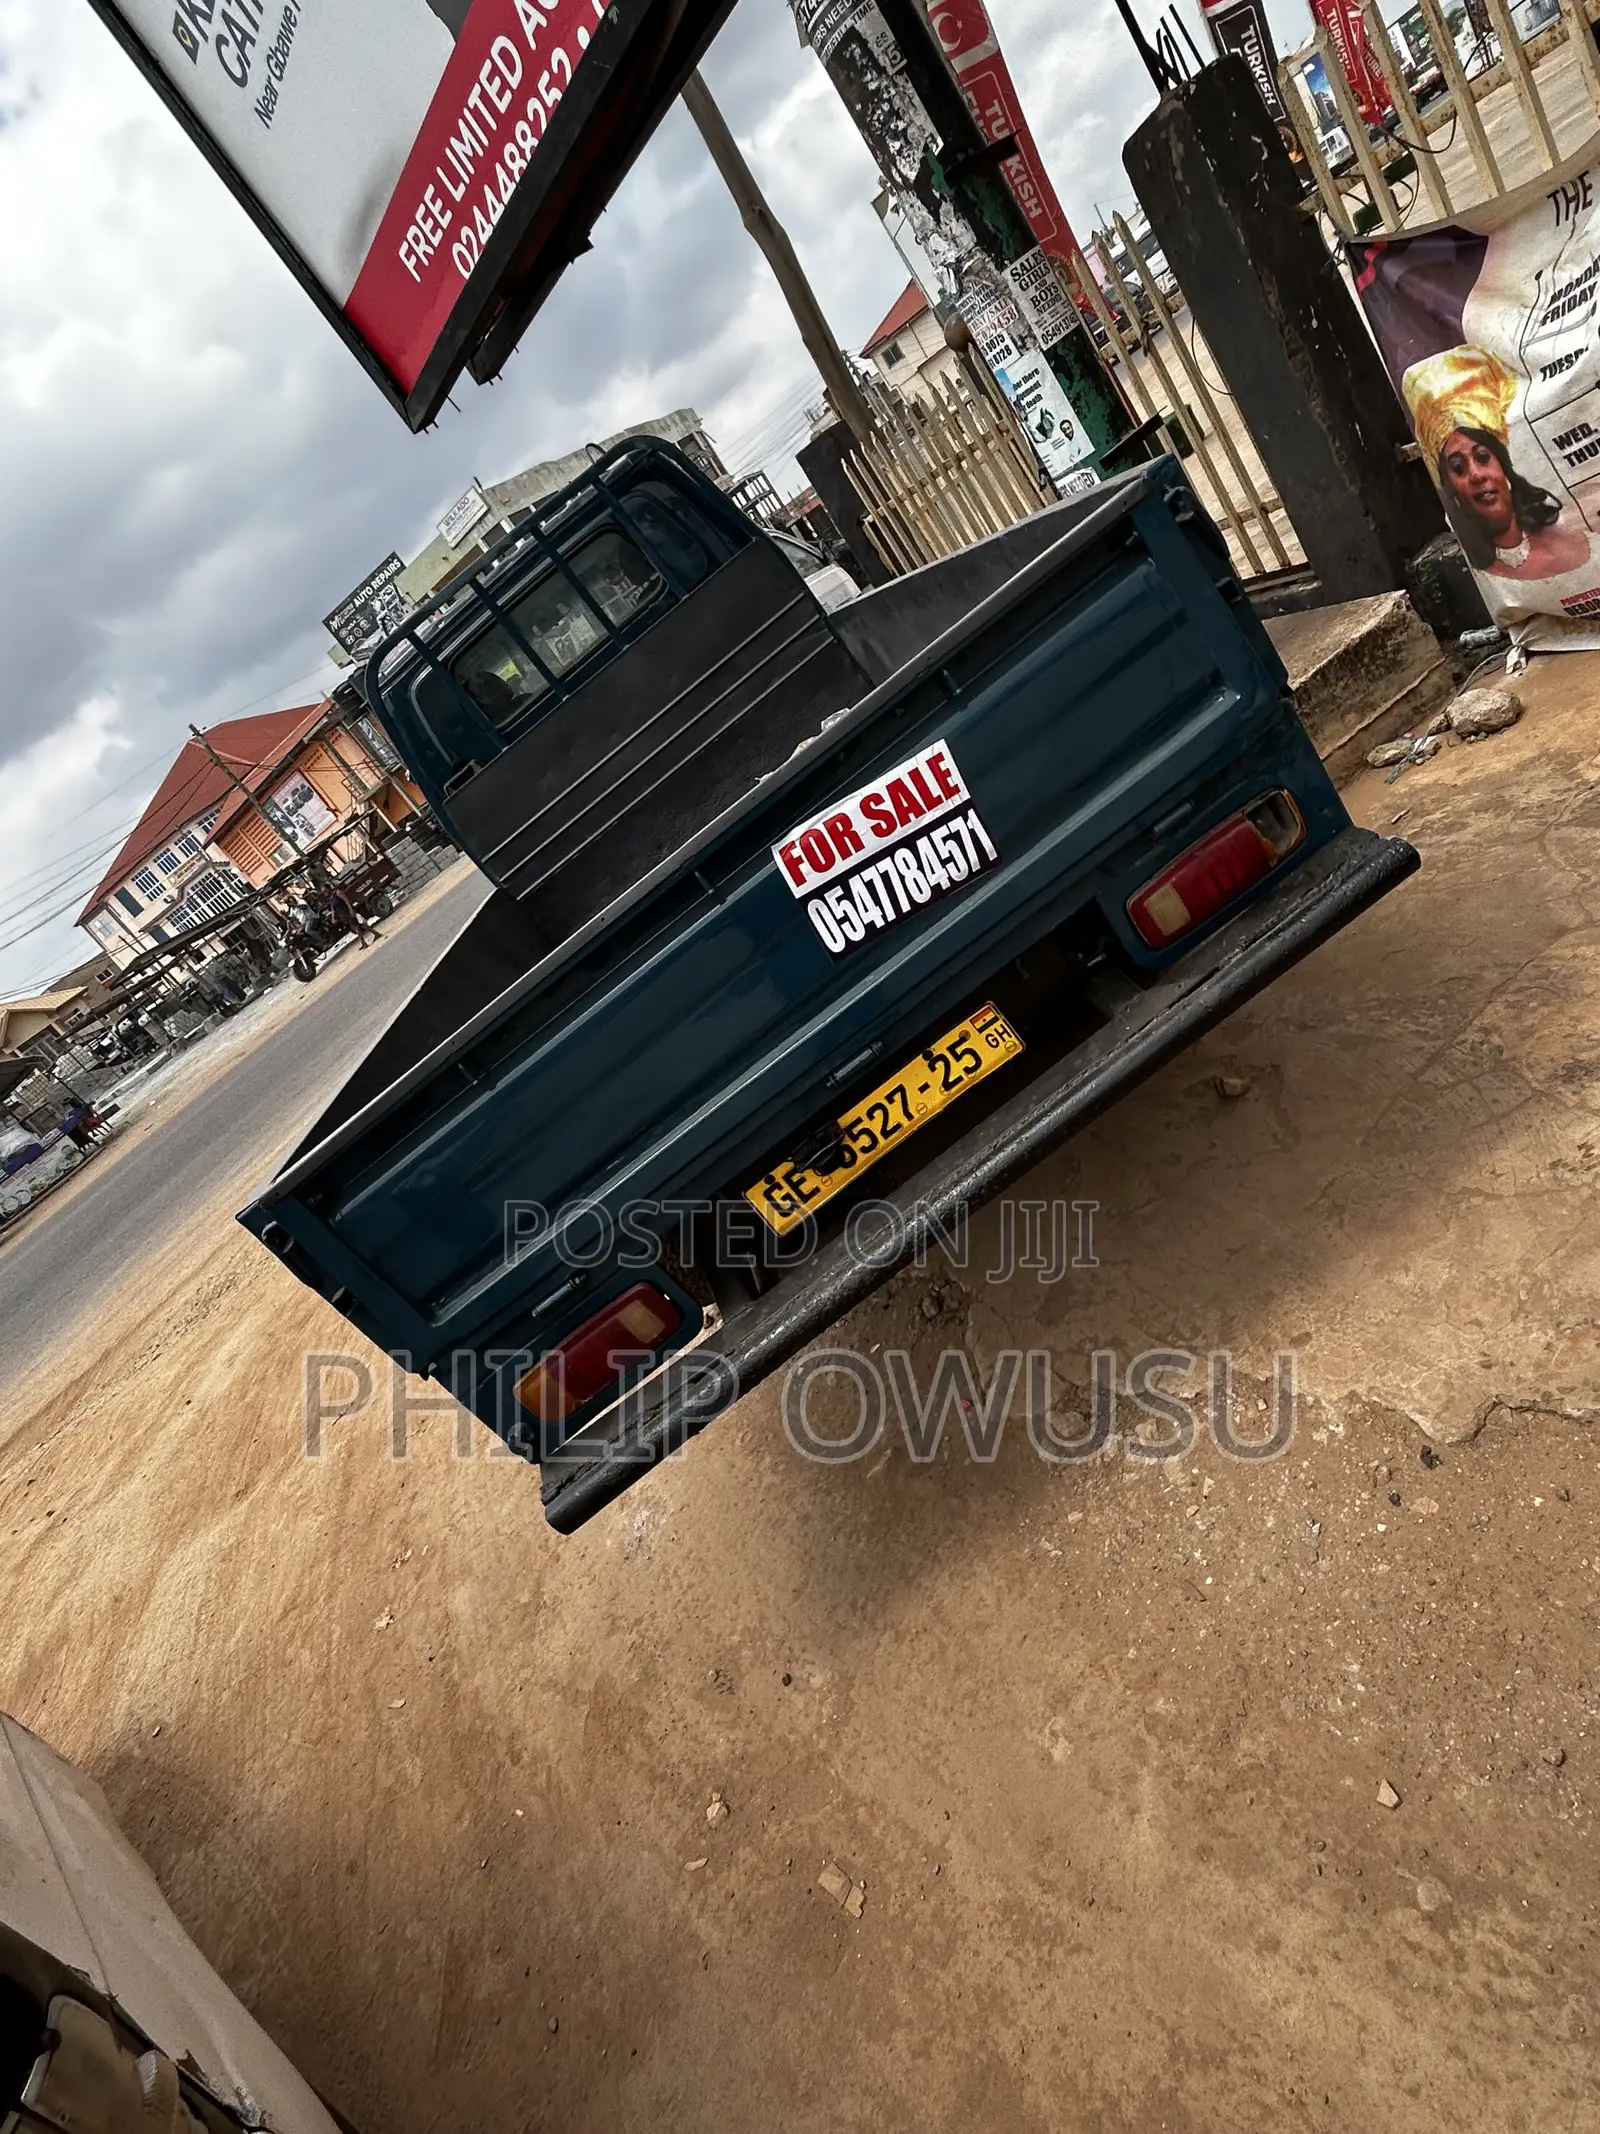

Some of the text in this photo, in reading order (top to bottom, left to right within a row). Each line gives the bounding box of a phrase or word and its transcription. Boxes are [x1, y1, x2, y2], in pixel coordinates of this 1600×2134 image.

[253, 5, 298, 129] Near Gbawe
[1240, 24, 1276, 105] TURKISH
[398, 184, 453, 283] FREE
[436, 35, 523, 202] LIMITED
[985, 99, 1042, 219] TUKISH
[1546, 170, 1593, 227] THE
[1010, 249, 1045, 282] SALES
[1018, 262, 1051, 292] GIRLS
[1034, 279, 1047, 292] AND
[1548, 254, 1600, 308] MONDA
[1029, 282, 1059, 309] BOYS
[1036, 295, 1062, 316] NEEDED
[1541, 281, 1598, 326] FRIDAY
[1551, 422, 1598, 451] WED.
[1562, 437, 1600, 468] THU
[353, 587, 374, 607] AUTO
[371, 558, 401, 591] REPAIRS
[779, 751, 961, 888] FOR SALE
[807, 808, 998, 953] 0547784571
[985, 1023, 1012, 1049] GH
